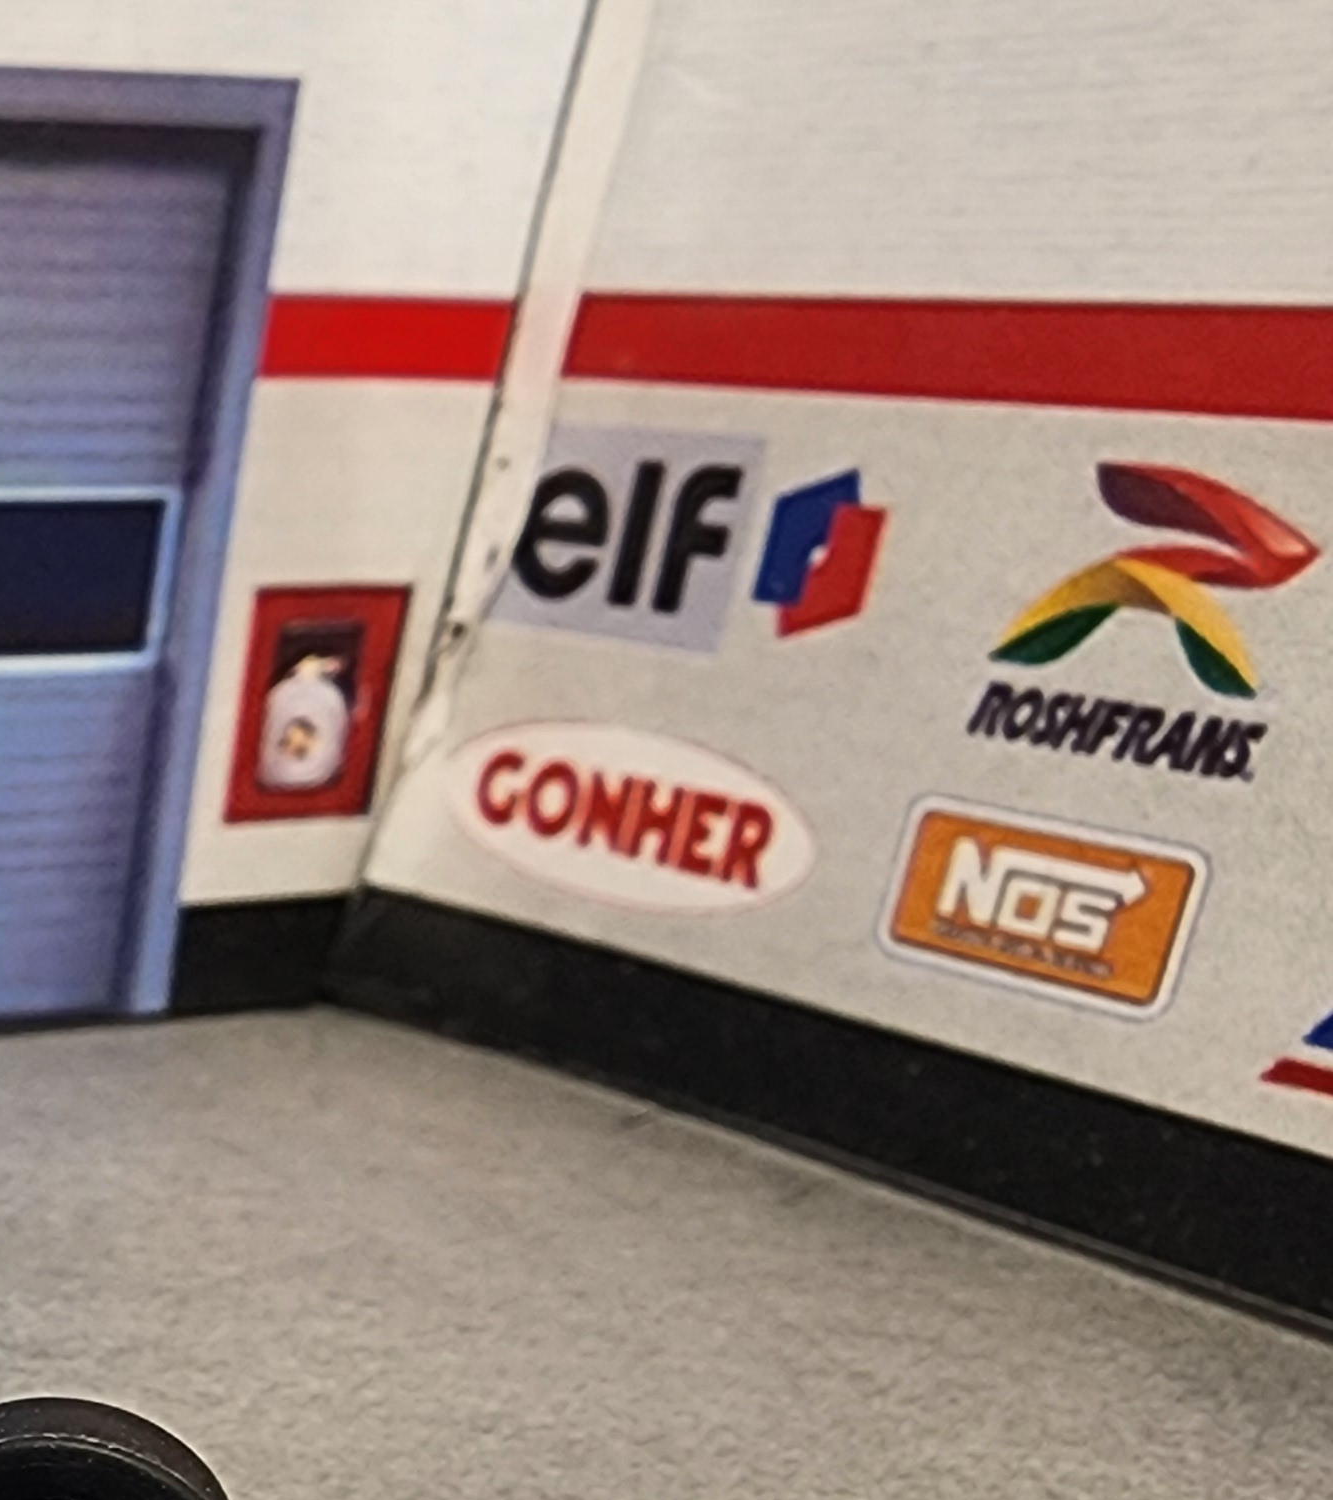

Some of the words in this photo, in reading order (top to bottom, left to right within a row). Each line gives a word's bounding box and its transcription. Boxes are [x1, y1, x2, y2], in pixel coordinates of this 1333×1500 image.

[512, 459, 744, 614] elf
[968, 682, 1267, 780] ROSHFRANS
[476, 750, 773, 890] GONHER
[937, 836, 1146, 954] NOS
